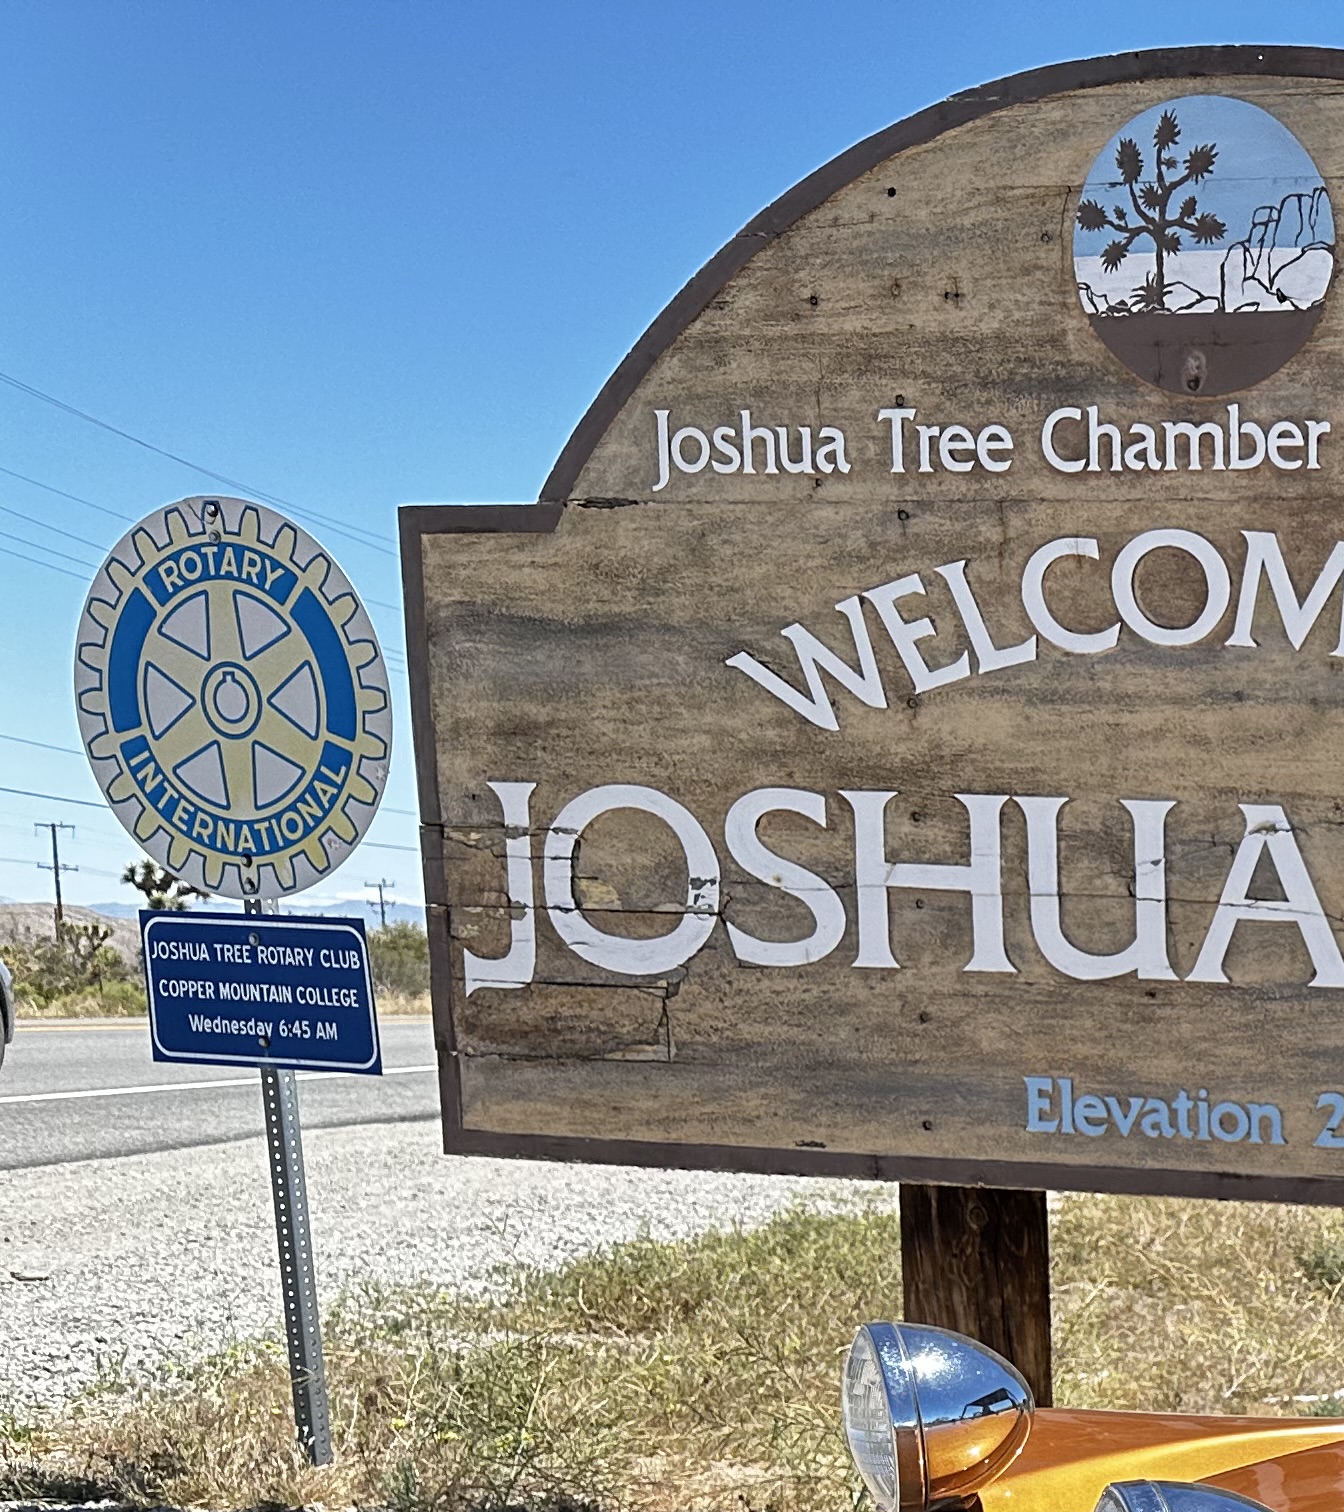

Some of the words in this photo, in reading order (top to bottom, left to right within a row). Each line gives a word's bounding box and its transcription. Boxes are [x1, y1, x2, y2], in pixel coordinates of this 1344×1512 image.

[652, 409, 851, 492] Joshua
[877, 408, 1014, 474] Tree
[1041, 404, 1331, 474] Chamber
[158, 546, 286, 592] ROTARY
[129, 750, 347, 853] INTERNATIONAL
[152, 941, 210, 962] JOSHUA
[213, 943, 252, 963] TREE
[258, 946, 313, 967] ROTARY
[320, 950, 360, 969] CLUB
[159, 979, 215, 1000] COPPER
[219, 982, 293, 1004] MOUNTAIN
[296, 986, 359, 1008] COLLEGE
[188, 1013, 273, 1038] Wednesday
[279, 1019, 311, 1039] 6:45
[316, 1021, 338, 1041] AM
[1023, 1076, 1288, 1145] Elevation
